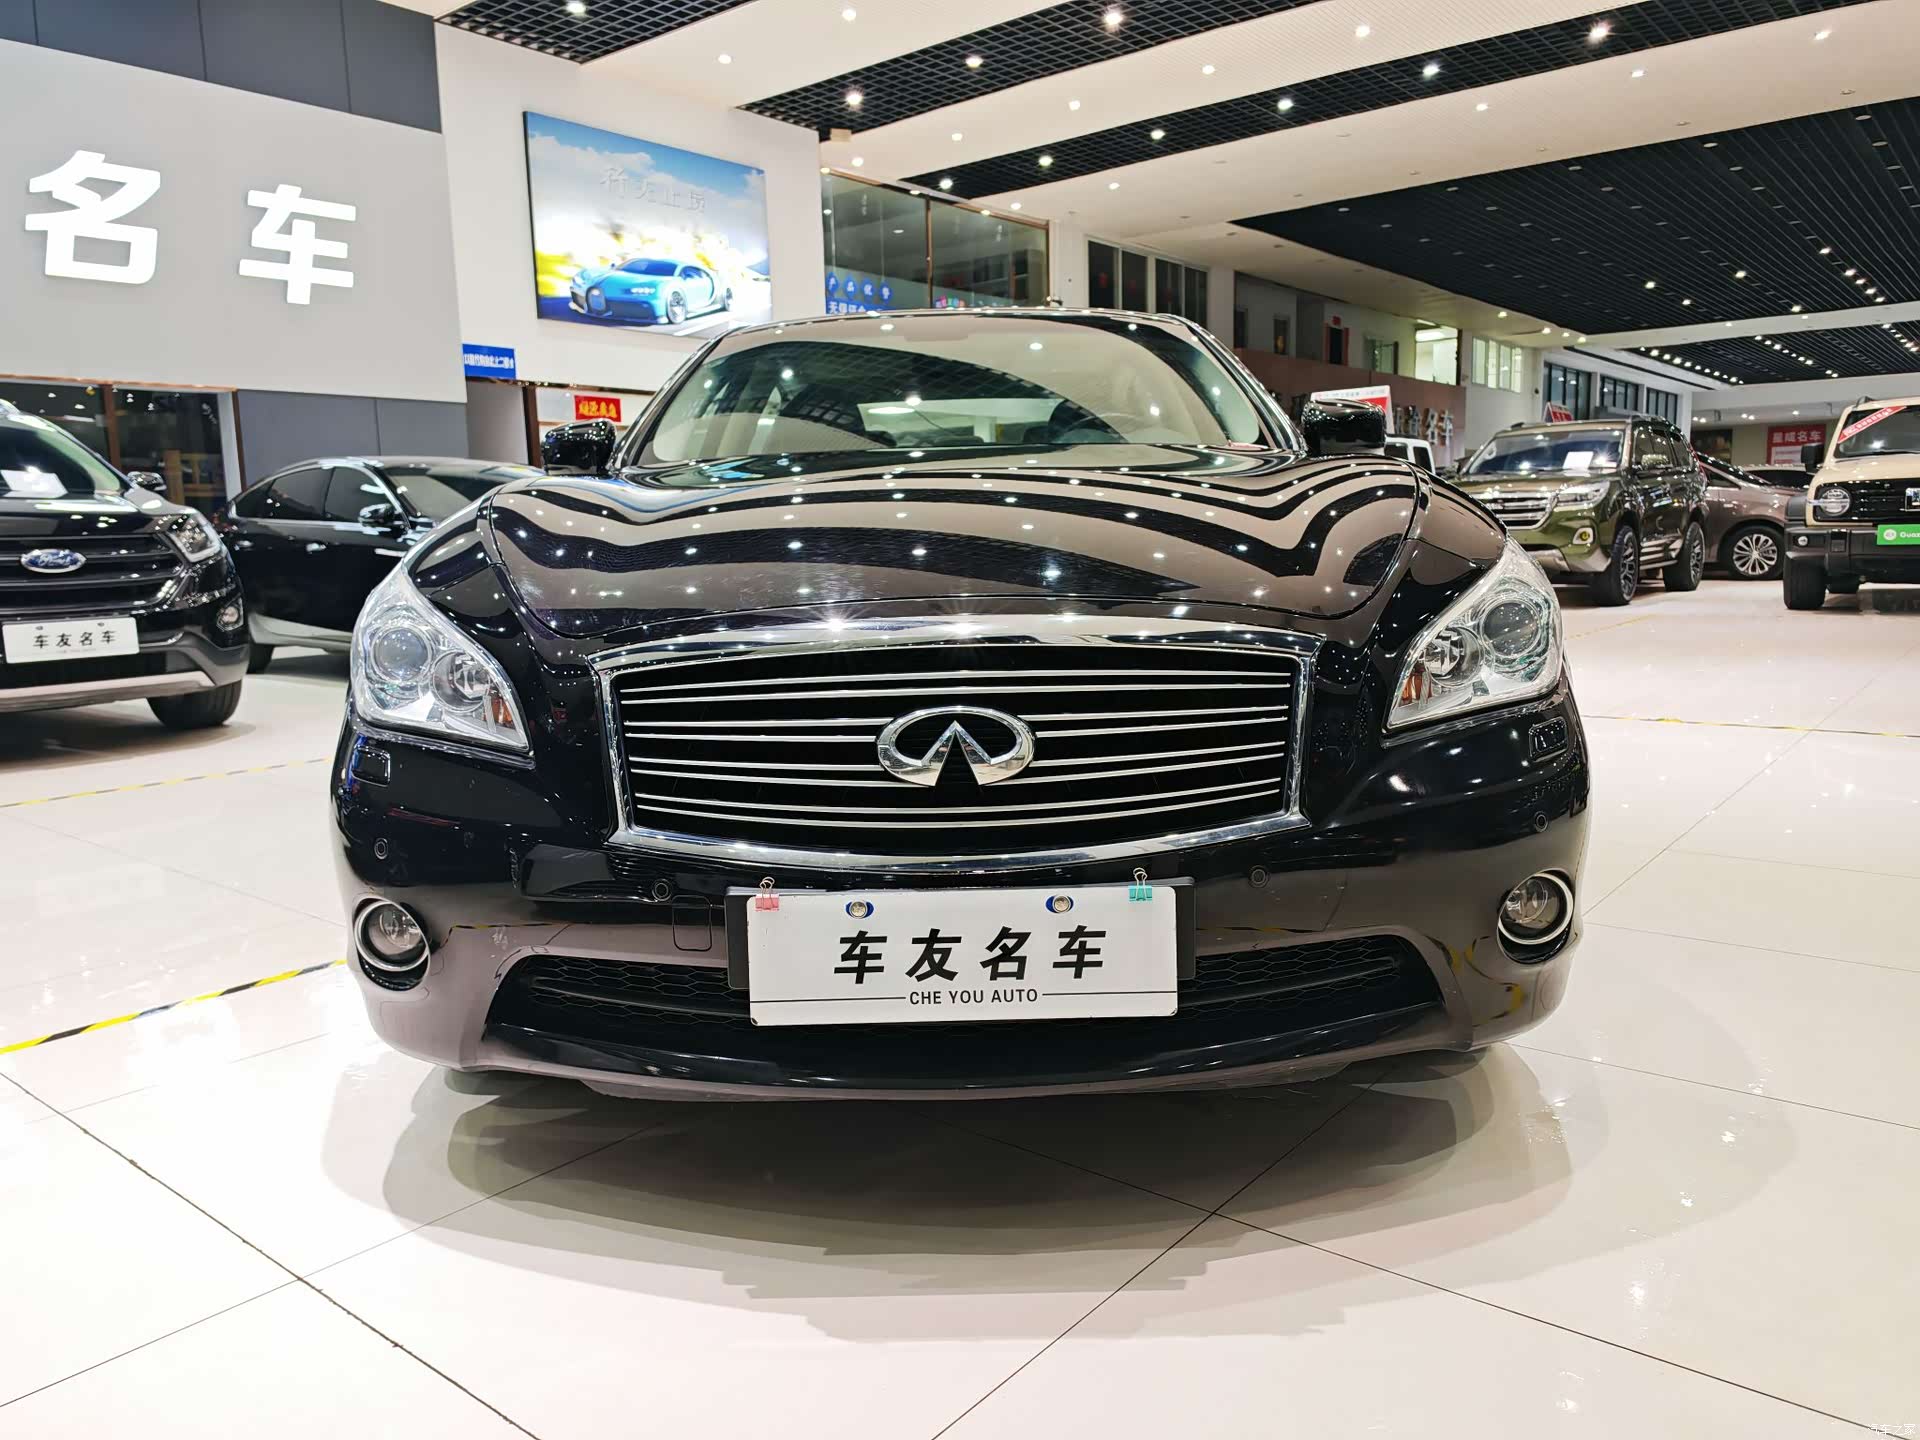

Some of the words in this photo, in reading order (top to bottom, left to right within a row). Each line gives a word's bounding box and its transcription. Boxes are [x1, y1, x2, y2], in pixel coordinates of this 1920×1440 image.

[25, 150, 356, 305] 名车
[33, 630, 117, 649] 车友名车
[833, 924, 1107, 984] 车友名车
[909, 990, 942, 1005] CHE
[948, 989, 984, 1004] YOU
[990, 988, 1039, 1003] AUTO
